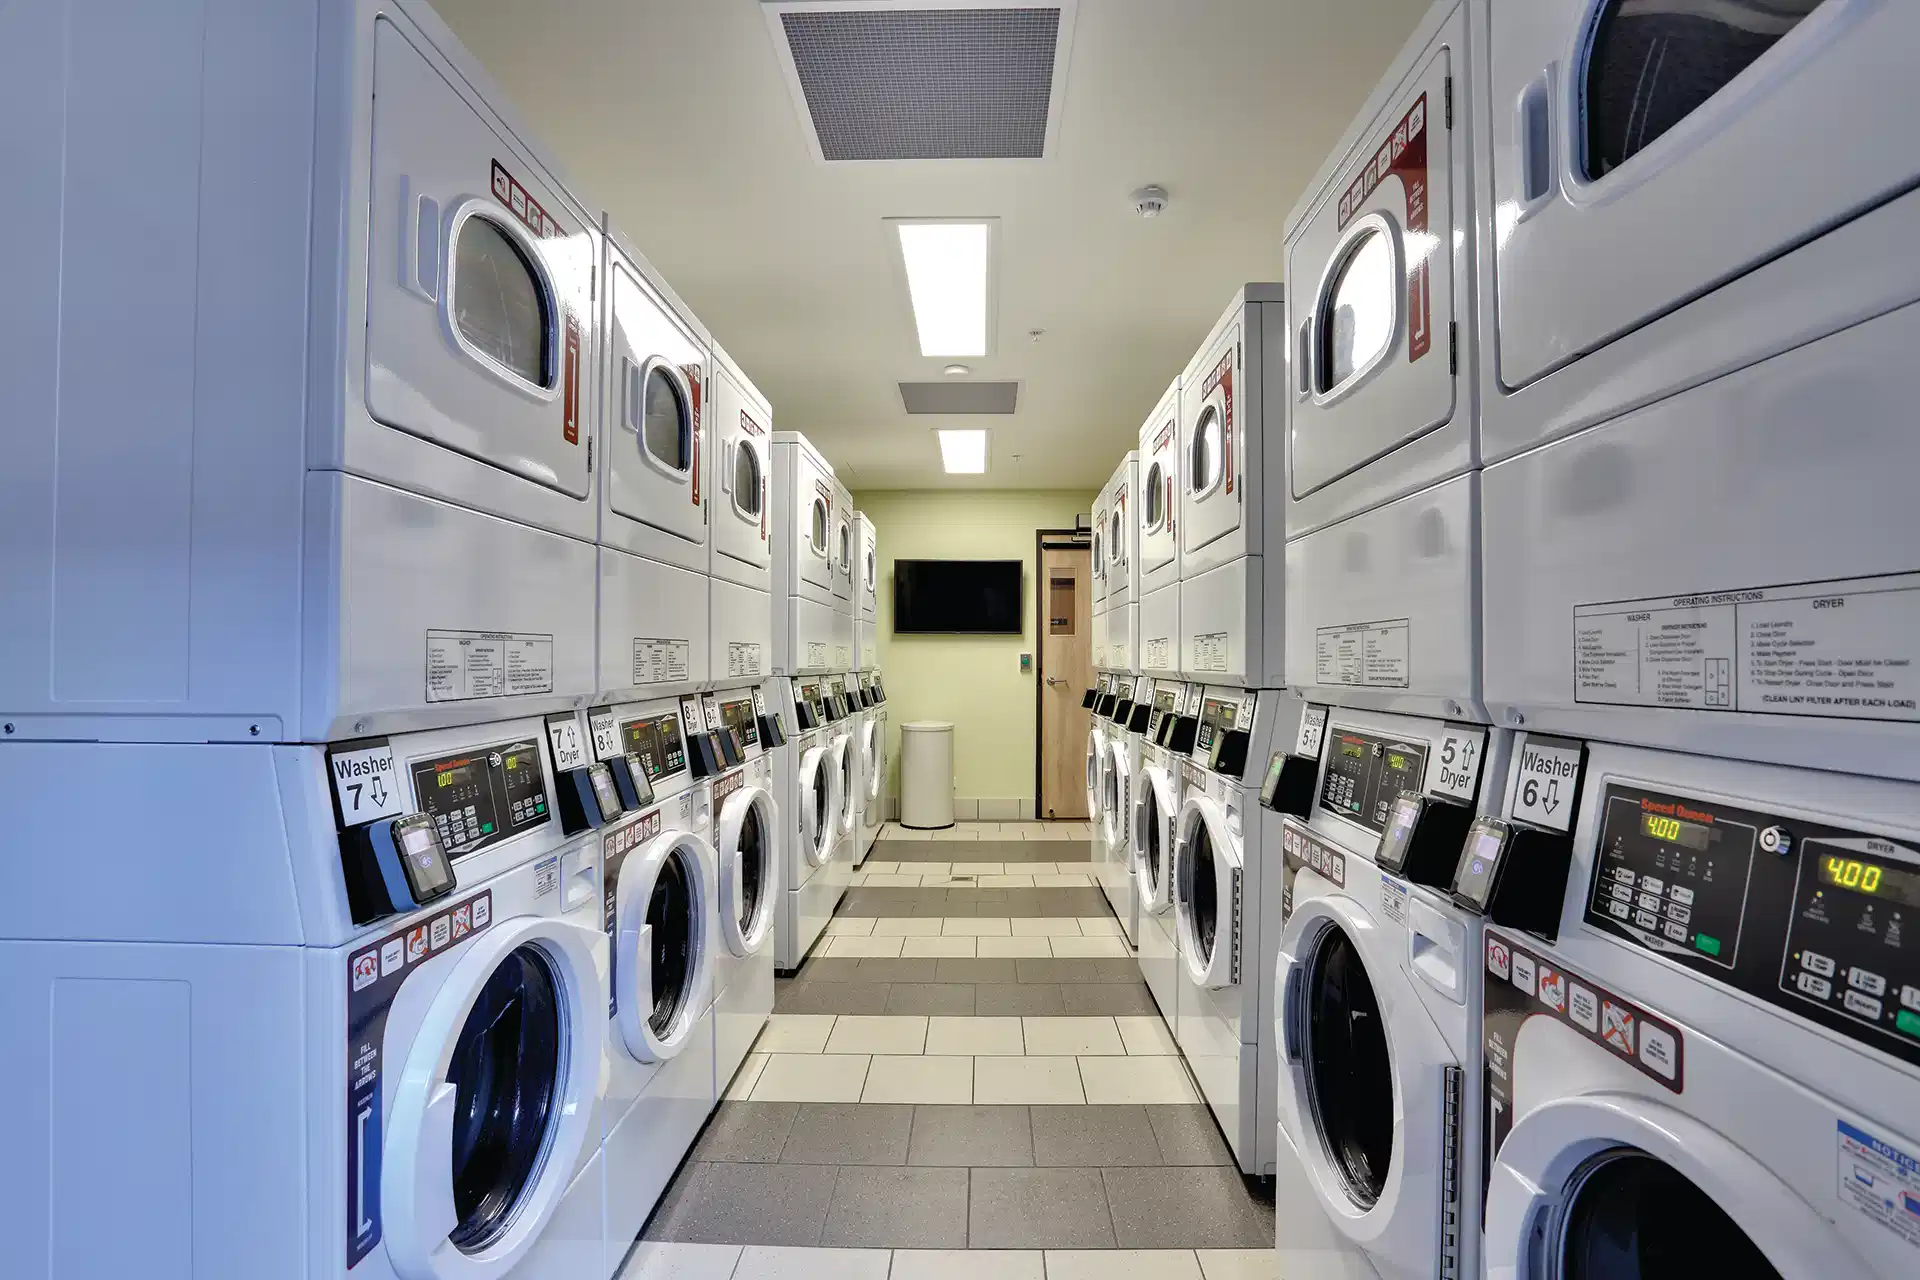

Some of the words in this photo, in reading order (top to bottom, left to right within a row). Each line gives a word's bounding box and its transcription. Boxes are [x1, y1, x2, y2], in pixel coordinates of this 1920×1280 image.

[1673, 594, 1710, 607] OPERATING
[1711, 591, 1763, 604] INSTRUCTIONS
[1812, 598, 1844, 609] DRYER
[1806, 696, 1832, 705] FILTER
[1833, 697, 1860, 706] AFTER
[1861, 698, 1886, 707] EACH
[684, 705, 691, 720] 8
[1304, 713, 1325, 728] Washer
[591, 718, 614, 733] Washer
[552, 728, 563, 749] 7
[597, 734, 605, 751] 8
[1302, 729, 1310, 746] 5
[559, 748, 580, 765] Dryer
[1440, 737, 1458, 765] 5
[334, 755, 392, 780] Washer
[1523, 751, 1580, 781] Washer
[1439, 766, 1471, 790] Dryer
[346, 782, 363, 811] 7
[1522, 777, 1539, 807] 6
[1640, 798, 1676, 816] Speed
[1676, 804, 1714, 823] Queen
[1648, 815, 1681, 841] 4.00
[1866, 840, 1896, 855] DRYER
[1827, 855, 1884, 893] 4.00
[1644, 934, 1665, 949] WASHER
[360, 1042, 371, 1054] FILL
[353, 1048, 377, 1070] BETWEEN
[360, 1062, 371, 1076] THE
[354, 1069, 376, 1091] ARROWS
